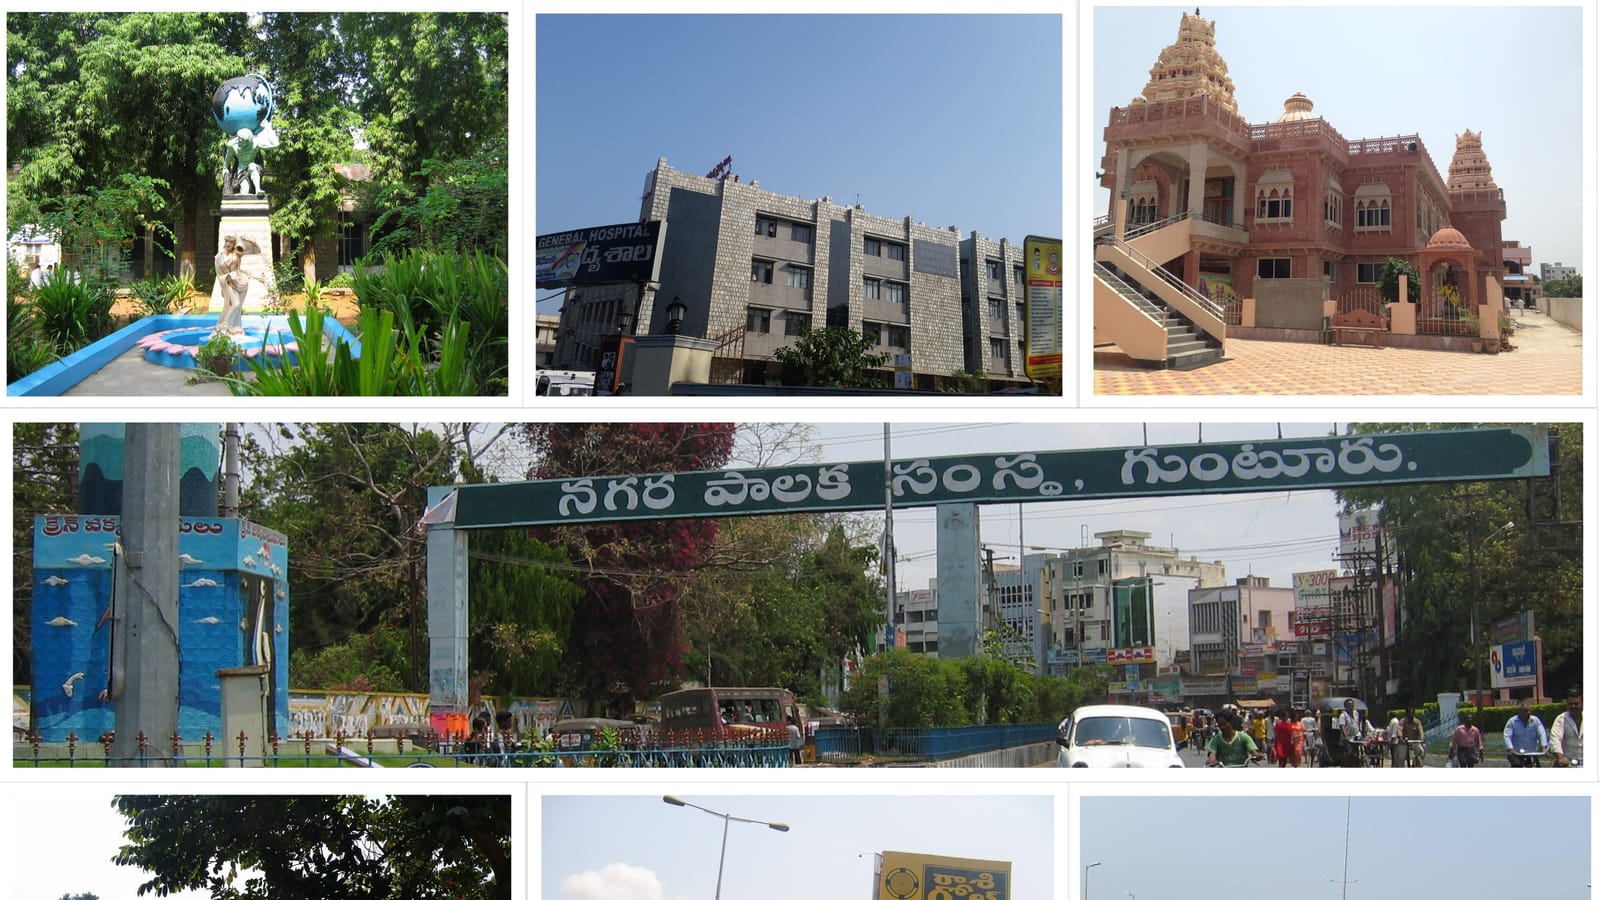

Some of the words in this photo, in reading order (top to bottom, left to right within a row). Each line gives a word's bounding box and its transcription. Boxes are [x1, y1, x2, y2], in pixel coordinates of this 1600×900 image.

[538, 232, 585, 248] GENERAL
[589, 225, 651, 242] HOSPITAL
[558, 474, 675, 517] నగర
[703, 463, 852, 506] పాలక
